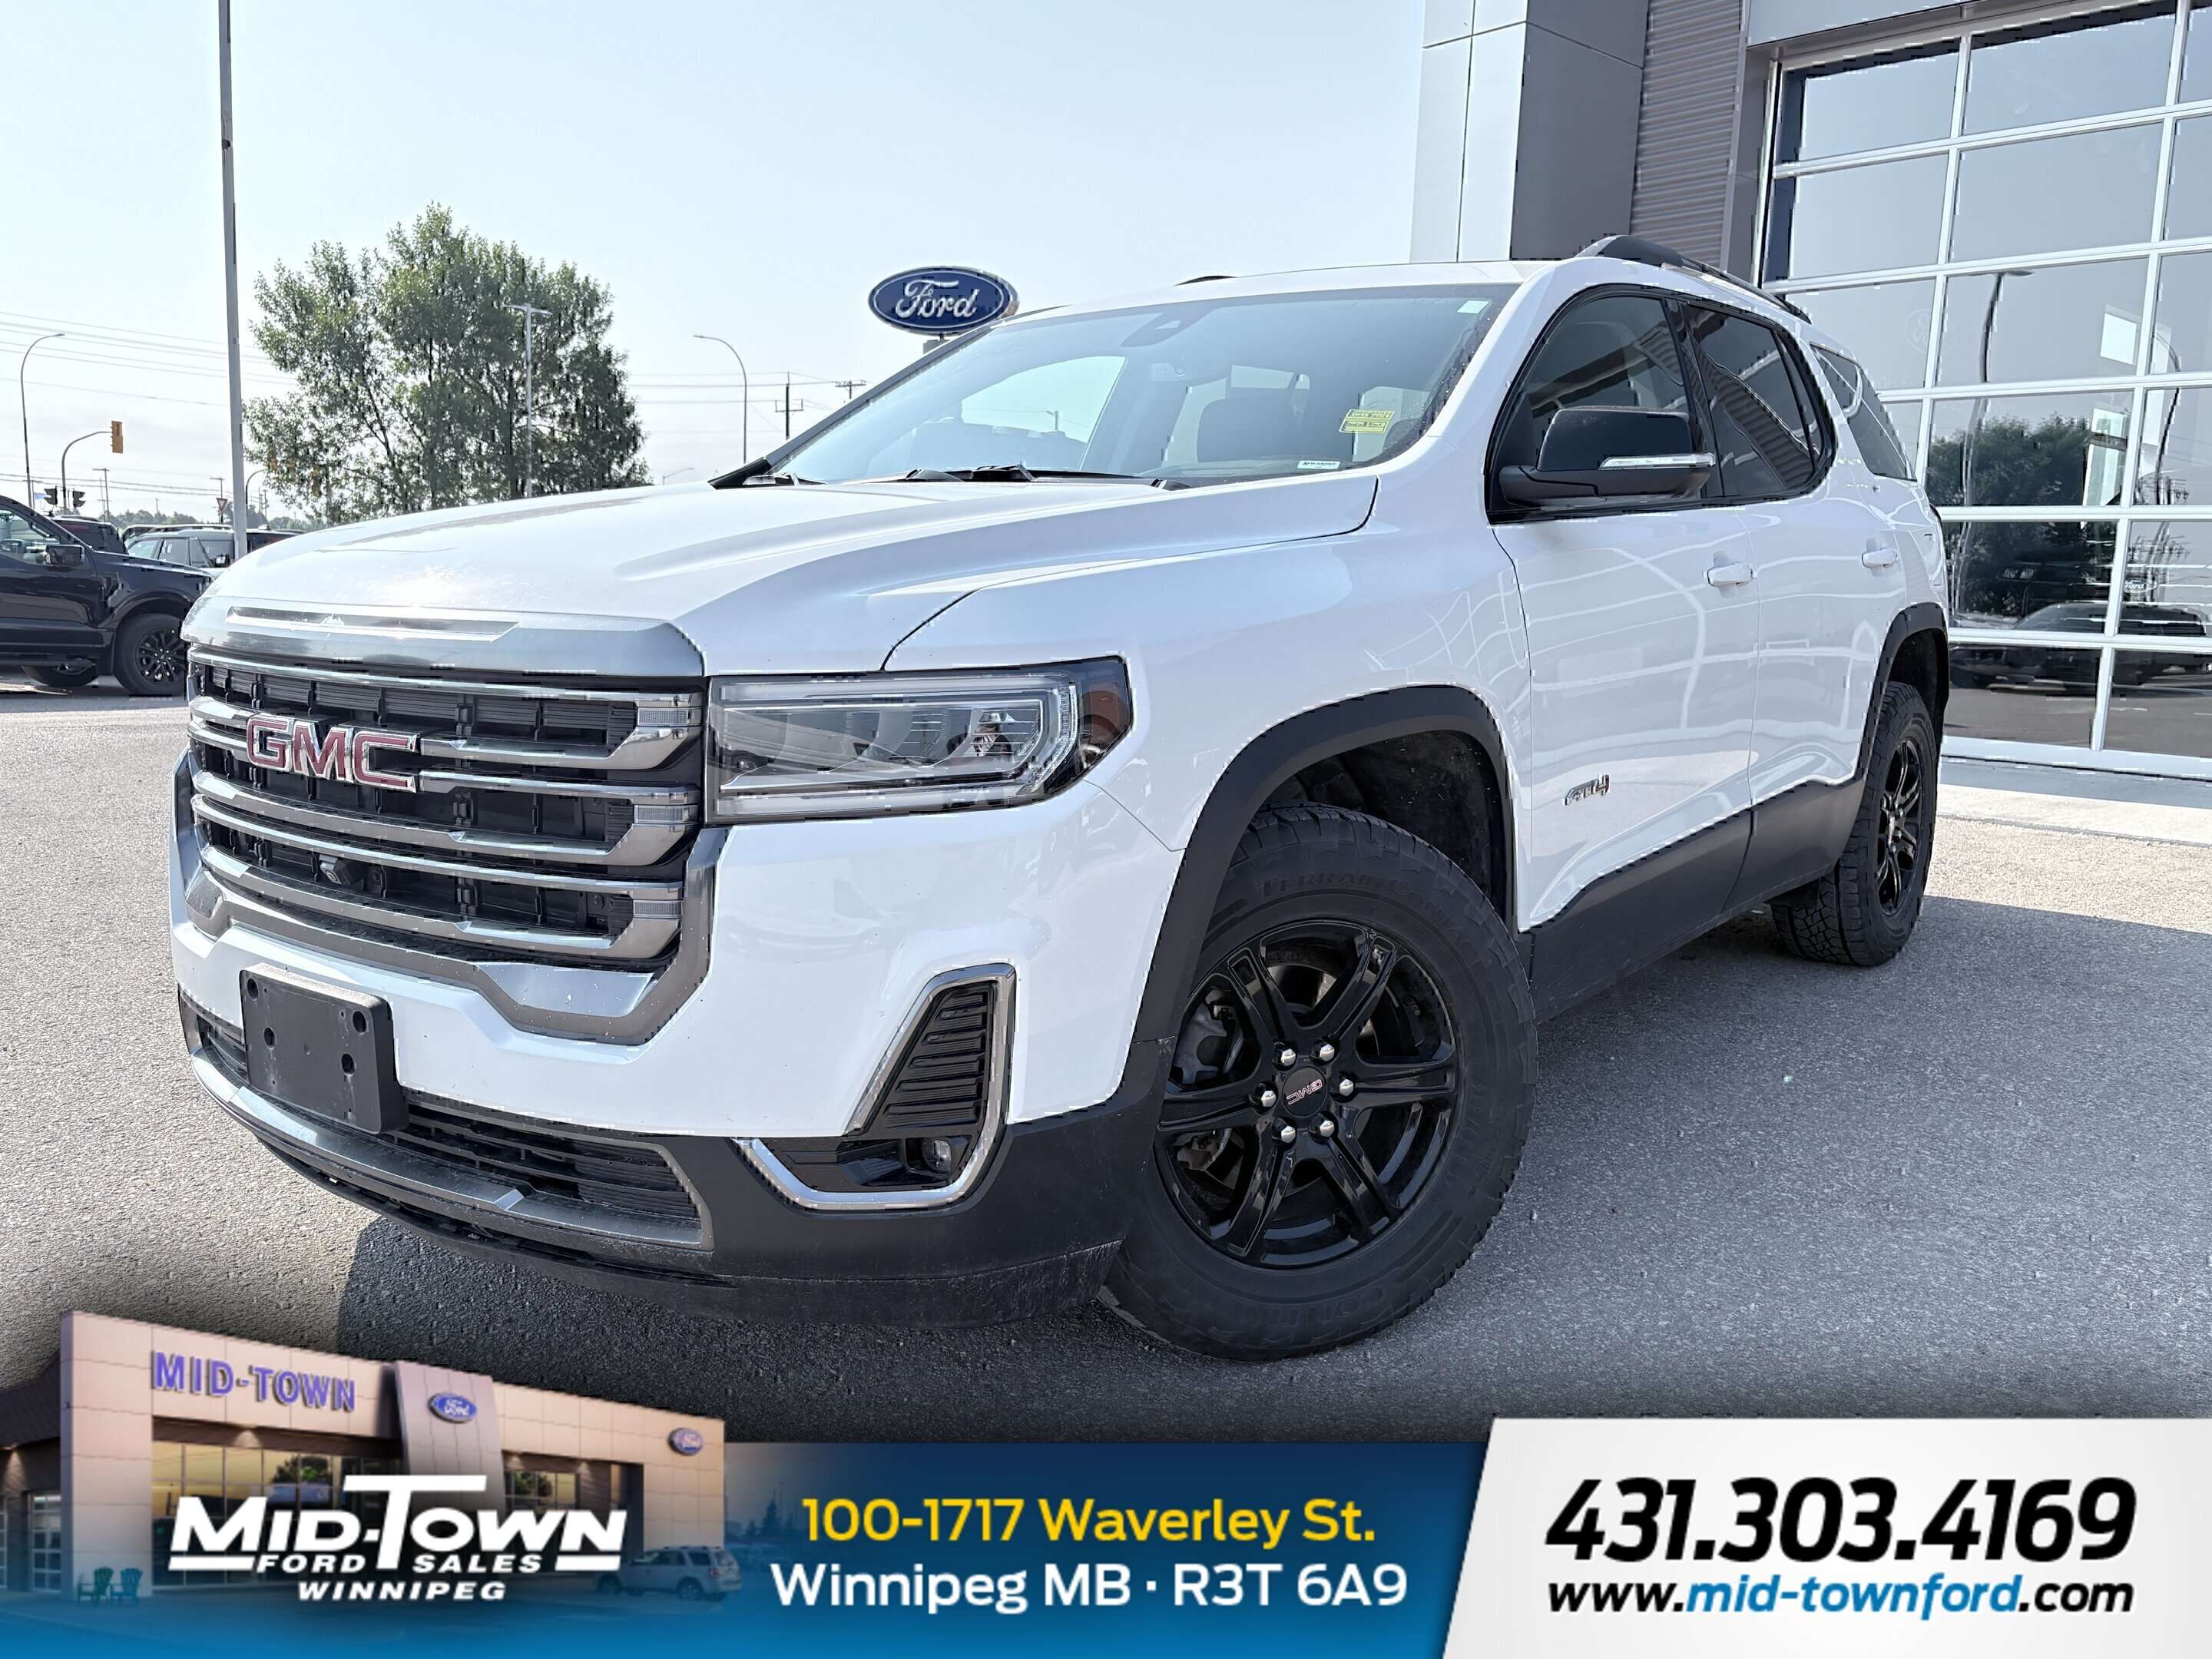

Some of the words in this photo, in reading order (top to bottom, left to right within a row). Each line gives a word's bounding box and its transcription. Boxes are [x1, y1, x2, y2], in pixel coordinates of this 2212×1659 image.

[896, 279, 980, 320] Ford
[247, 713, 419, 793] GMC
[1286, 1078, 1323, 1105] GMC
